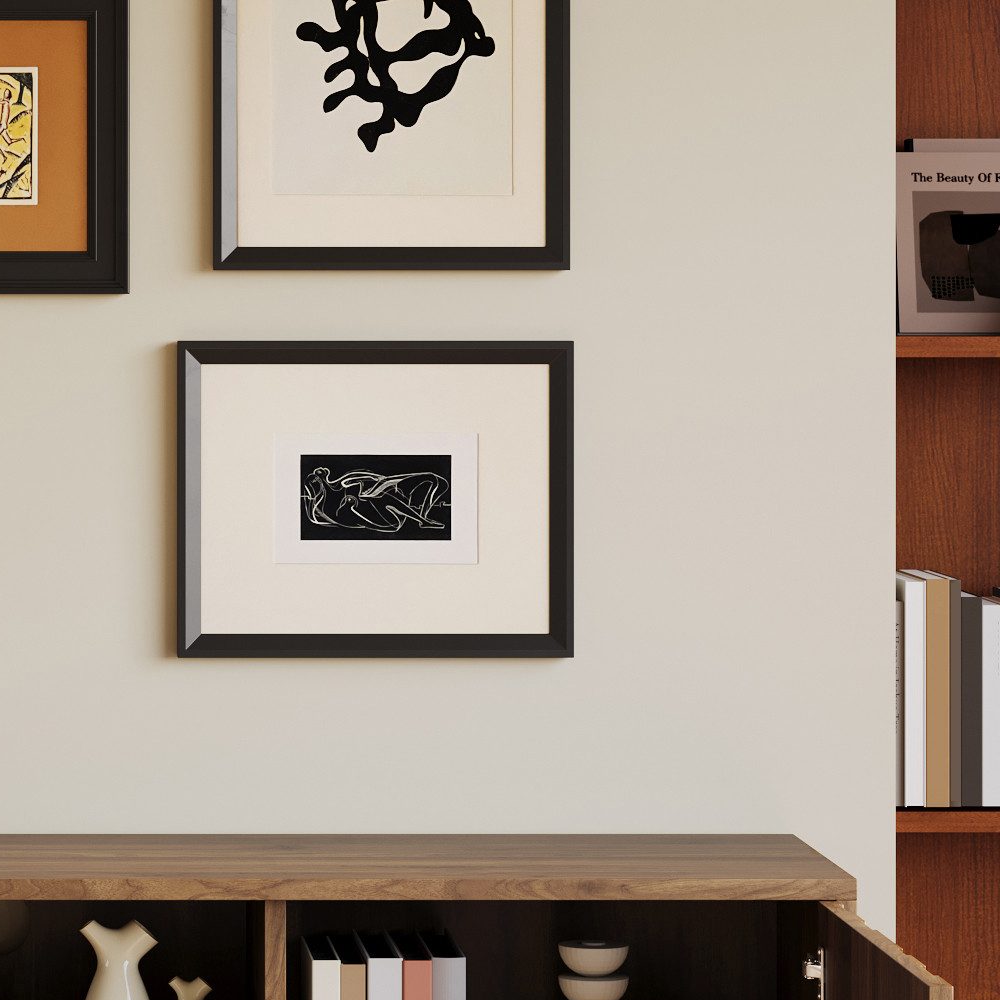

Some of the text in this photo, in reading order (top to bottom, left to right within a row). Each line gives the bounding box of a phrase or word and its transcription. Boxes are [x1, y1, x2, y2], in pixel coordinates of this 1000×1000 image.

[911, 172, 933, 183] The
[936, 172, 974, 186] Beauty
[977, 172, 992, 183] Of
